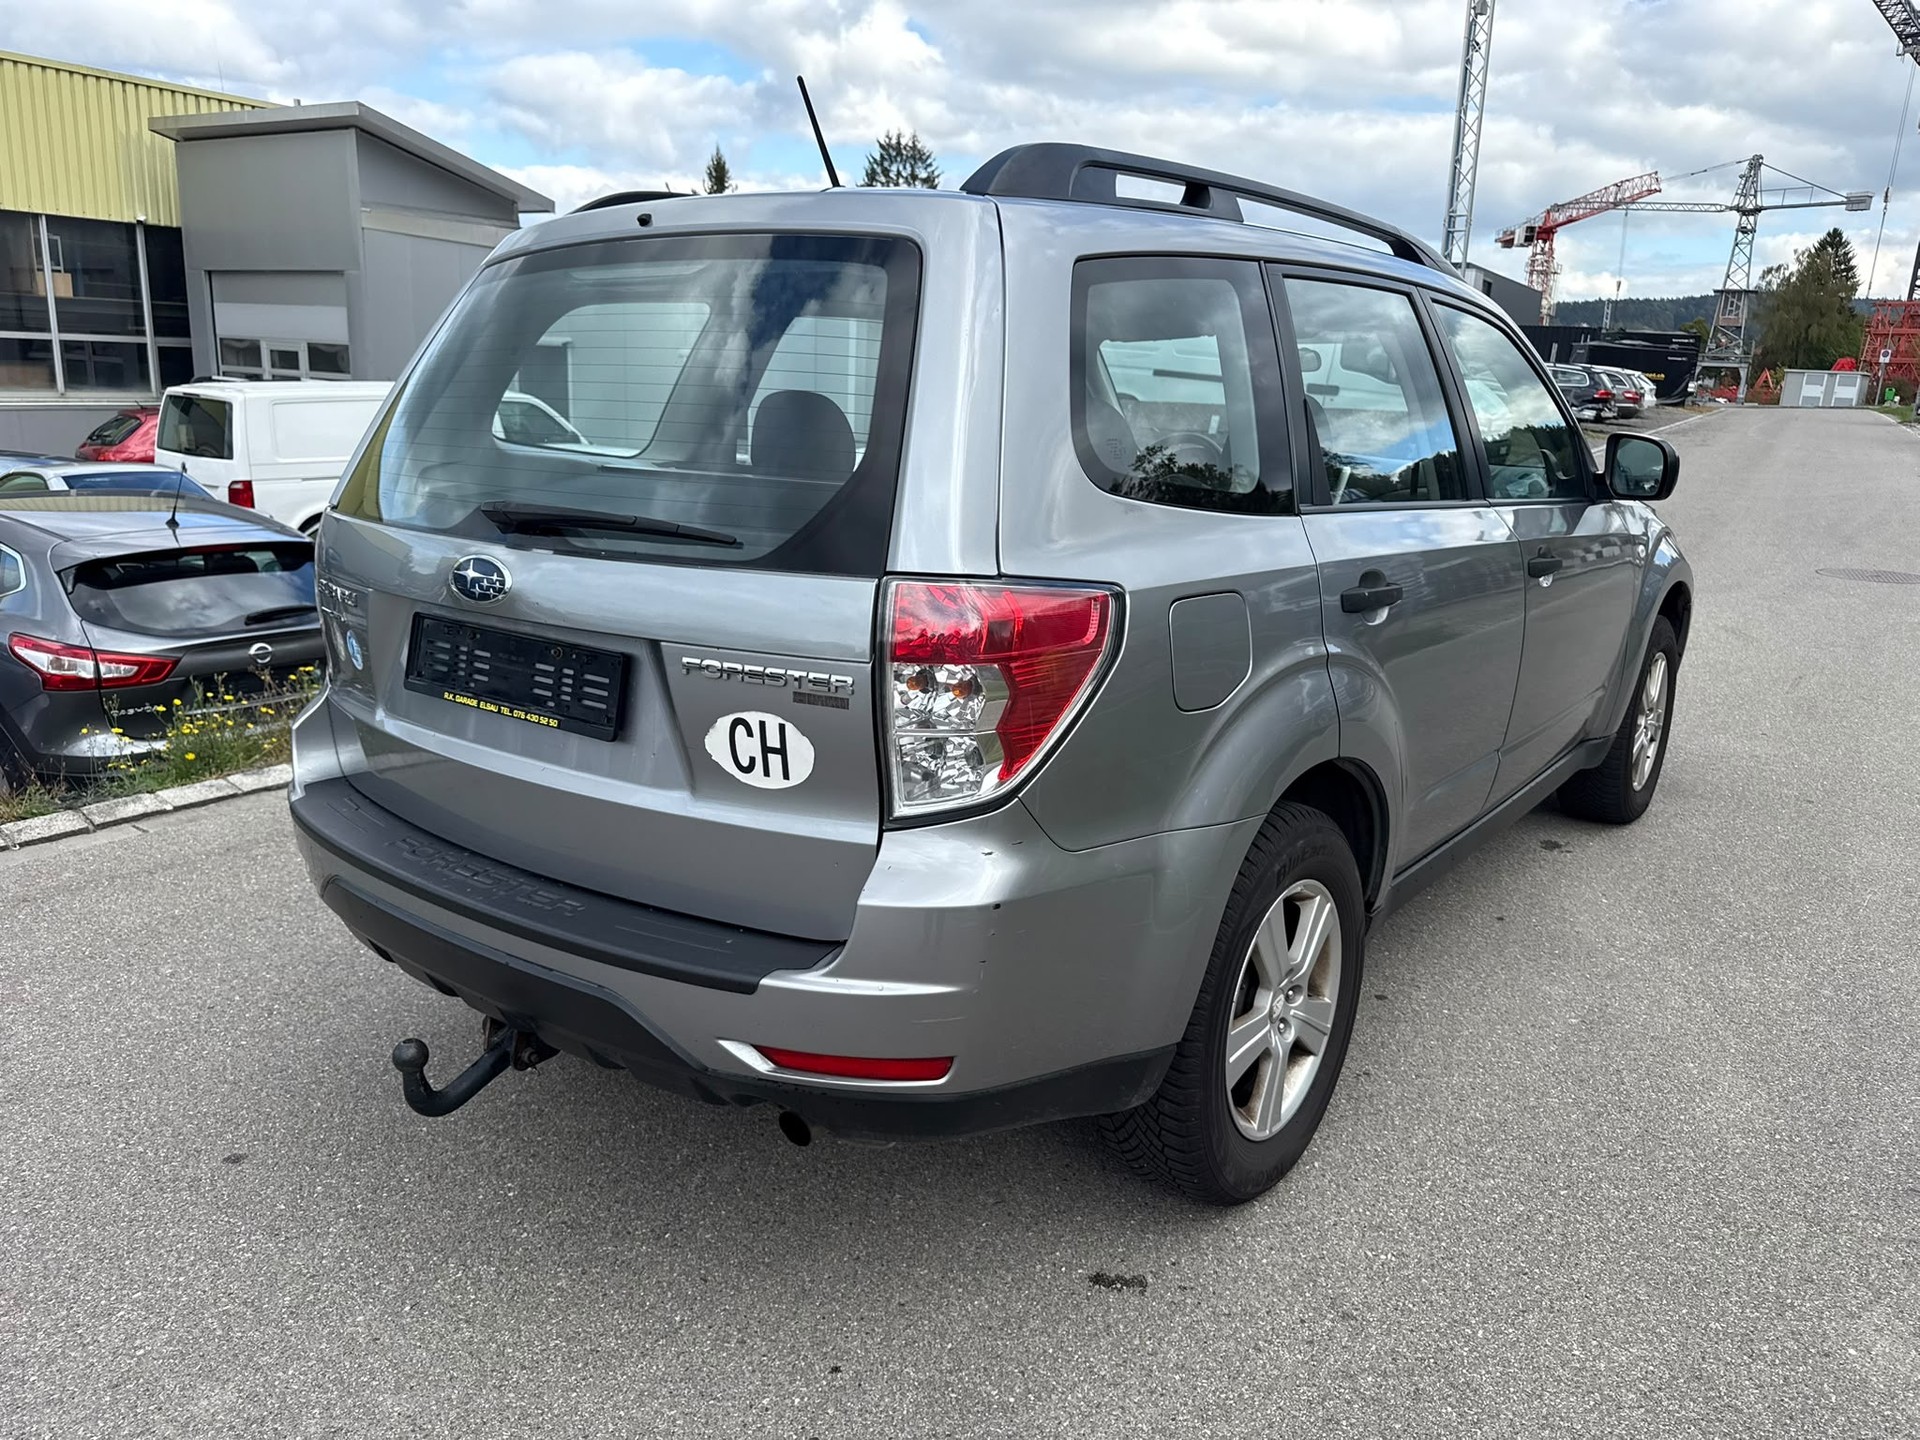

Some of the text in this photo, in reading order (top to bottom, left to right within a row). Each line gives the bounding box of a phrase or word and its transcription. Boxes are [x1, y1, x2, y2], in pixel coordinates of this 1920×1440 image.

[681, 656, 855, 695] FORESTER
[455, 695, 478, 707] GARAGE
[479, 701, 499, 712] ELSAU
[500, 707, 513, 716] TEL.
[526, 713, 539, 723] 430
[539, 716, 548, 725] 52
[548, 718, 558, 727] 50
[728, 716, 791, 781] CH
[385, 837, 587, 917] FORESTER
